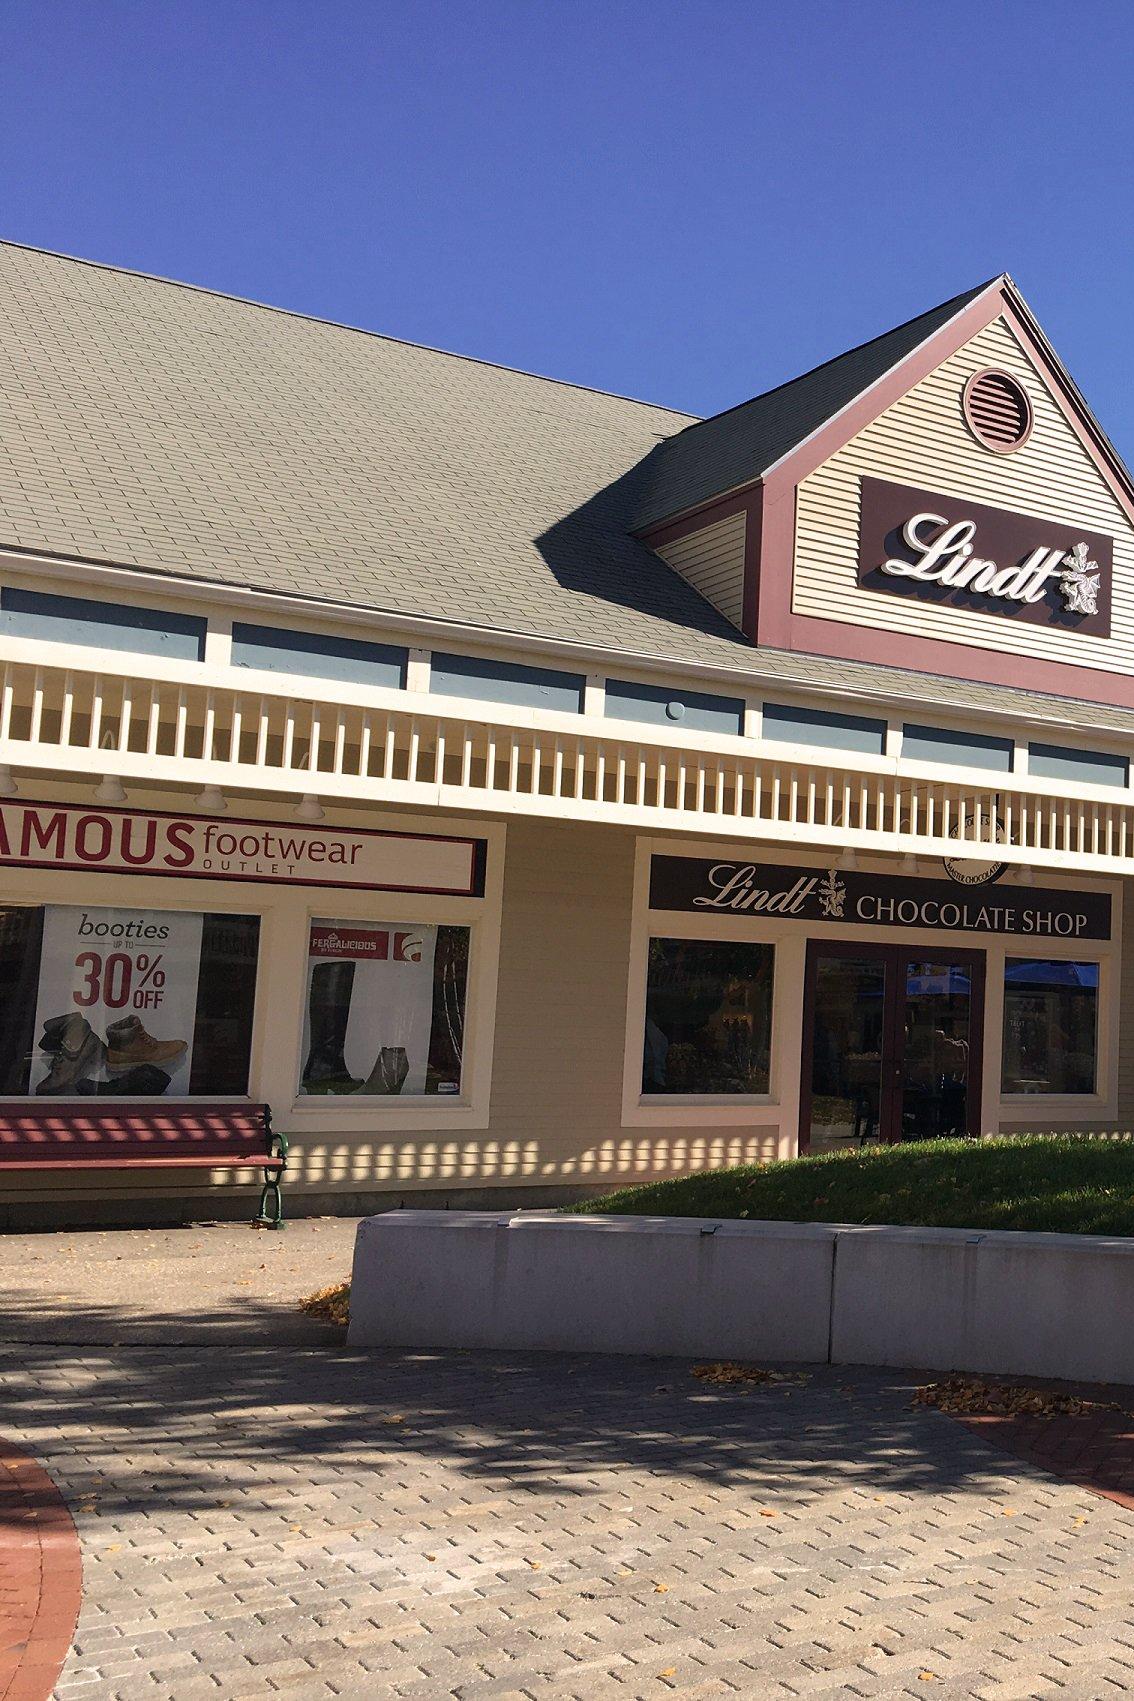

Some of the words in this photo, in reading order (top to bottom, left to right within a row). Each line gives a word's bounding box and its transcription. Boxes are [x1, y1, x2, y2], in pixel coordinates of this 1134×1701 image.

[881, 512, 1067, 604] Lindt
[203, 825, 363, 864] footwear
[203, 859, 296, 875] OUTLET
[693, 864, 818, 914] Lindt
[856, 895, 1015, 931] CHOCOLATE
[1022, 910, 1087, 935] SHOP
[78, 913, 170, 939] booties
[113, 940, 122, 949] UP
[125, 941, 134, 949] TO
[312, 938, 377, 950] FERGALICIOUS
[73, 951, 166, 1008] 30%
[133, 989, 164, 1009] OFF
